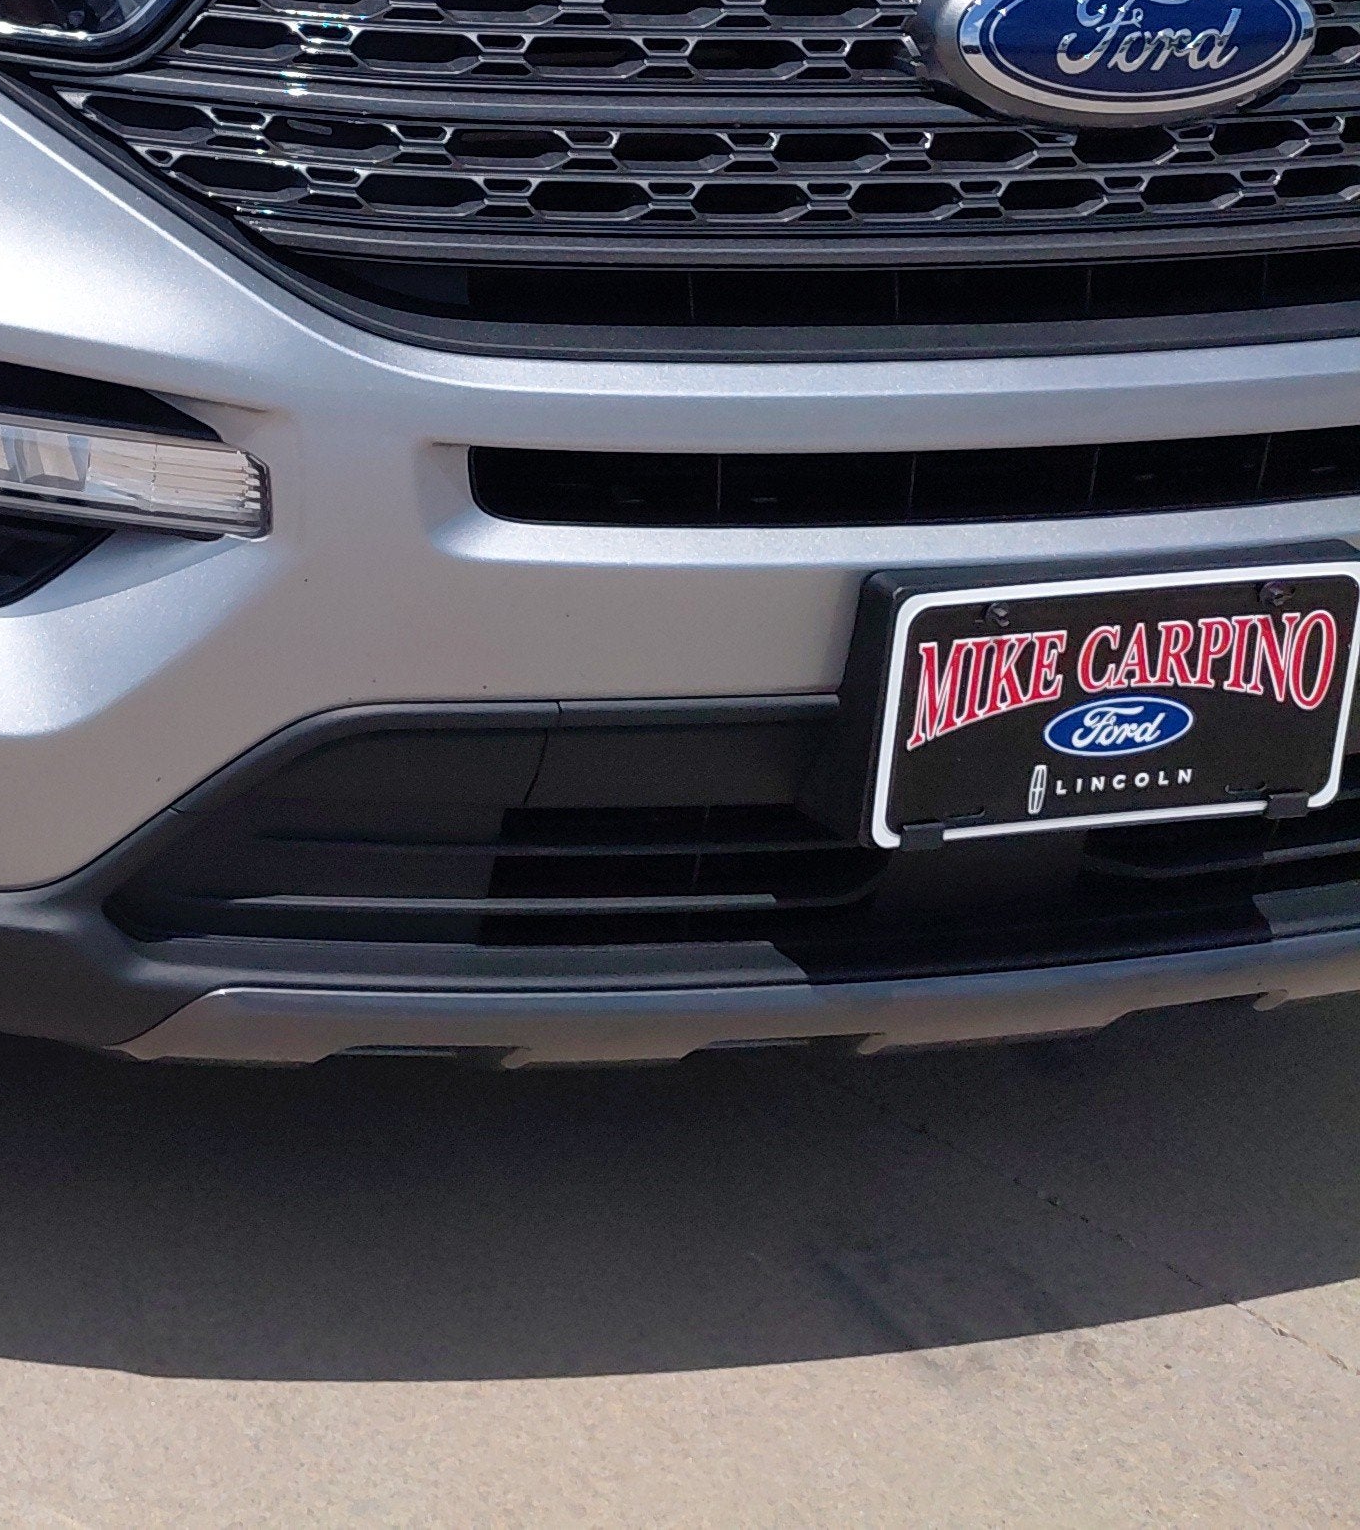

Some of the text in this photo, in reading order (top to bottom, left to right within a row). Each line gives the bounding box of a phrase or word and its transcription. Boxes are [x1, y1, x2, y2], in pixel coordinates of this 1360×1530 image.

[906, 609, 1337, 751] MIKE CARPINO
[1071, 705, 1166, 748] Ford
[1055, 769, 1193, 796] LINCOLN
